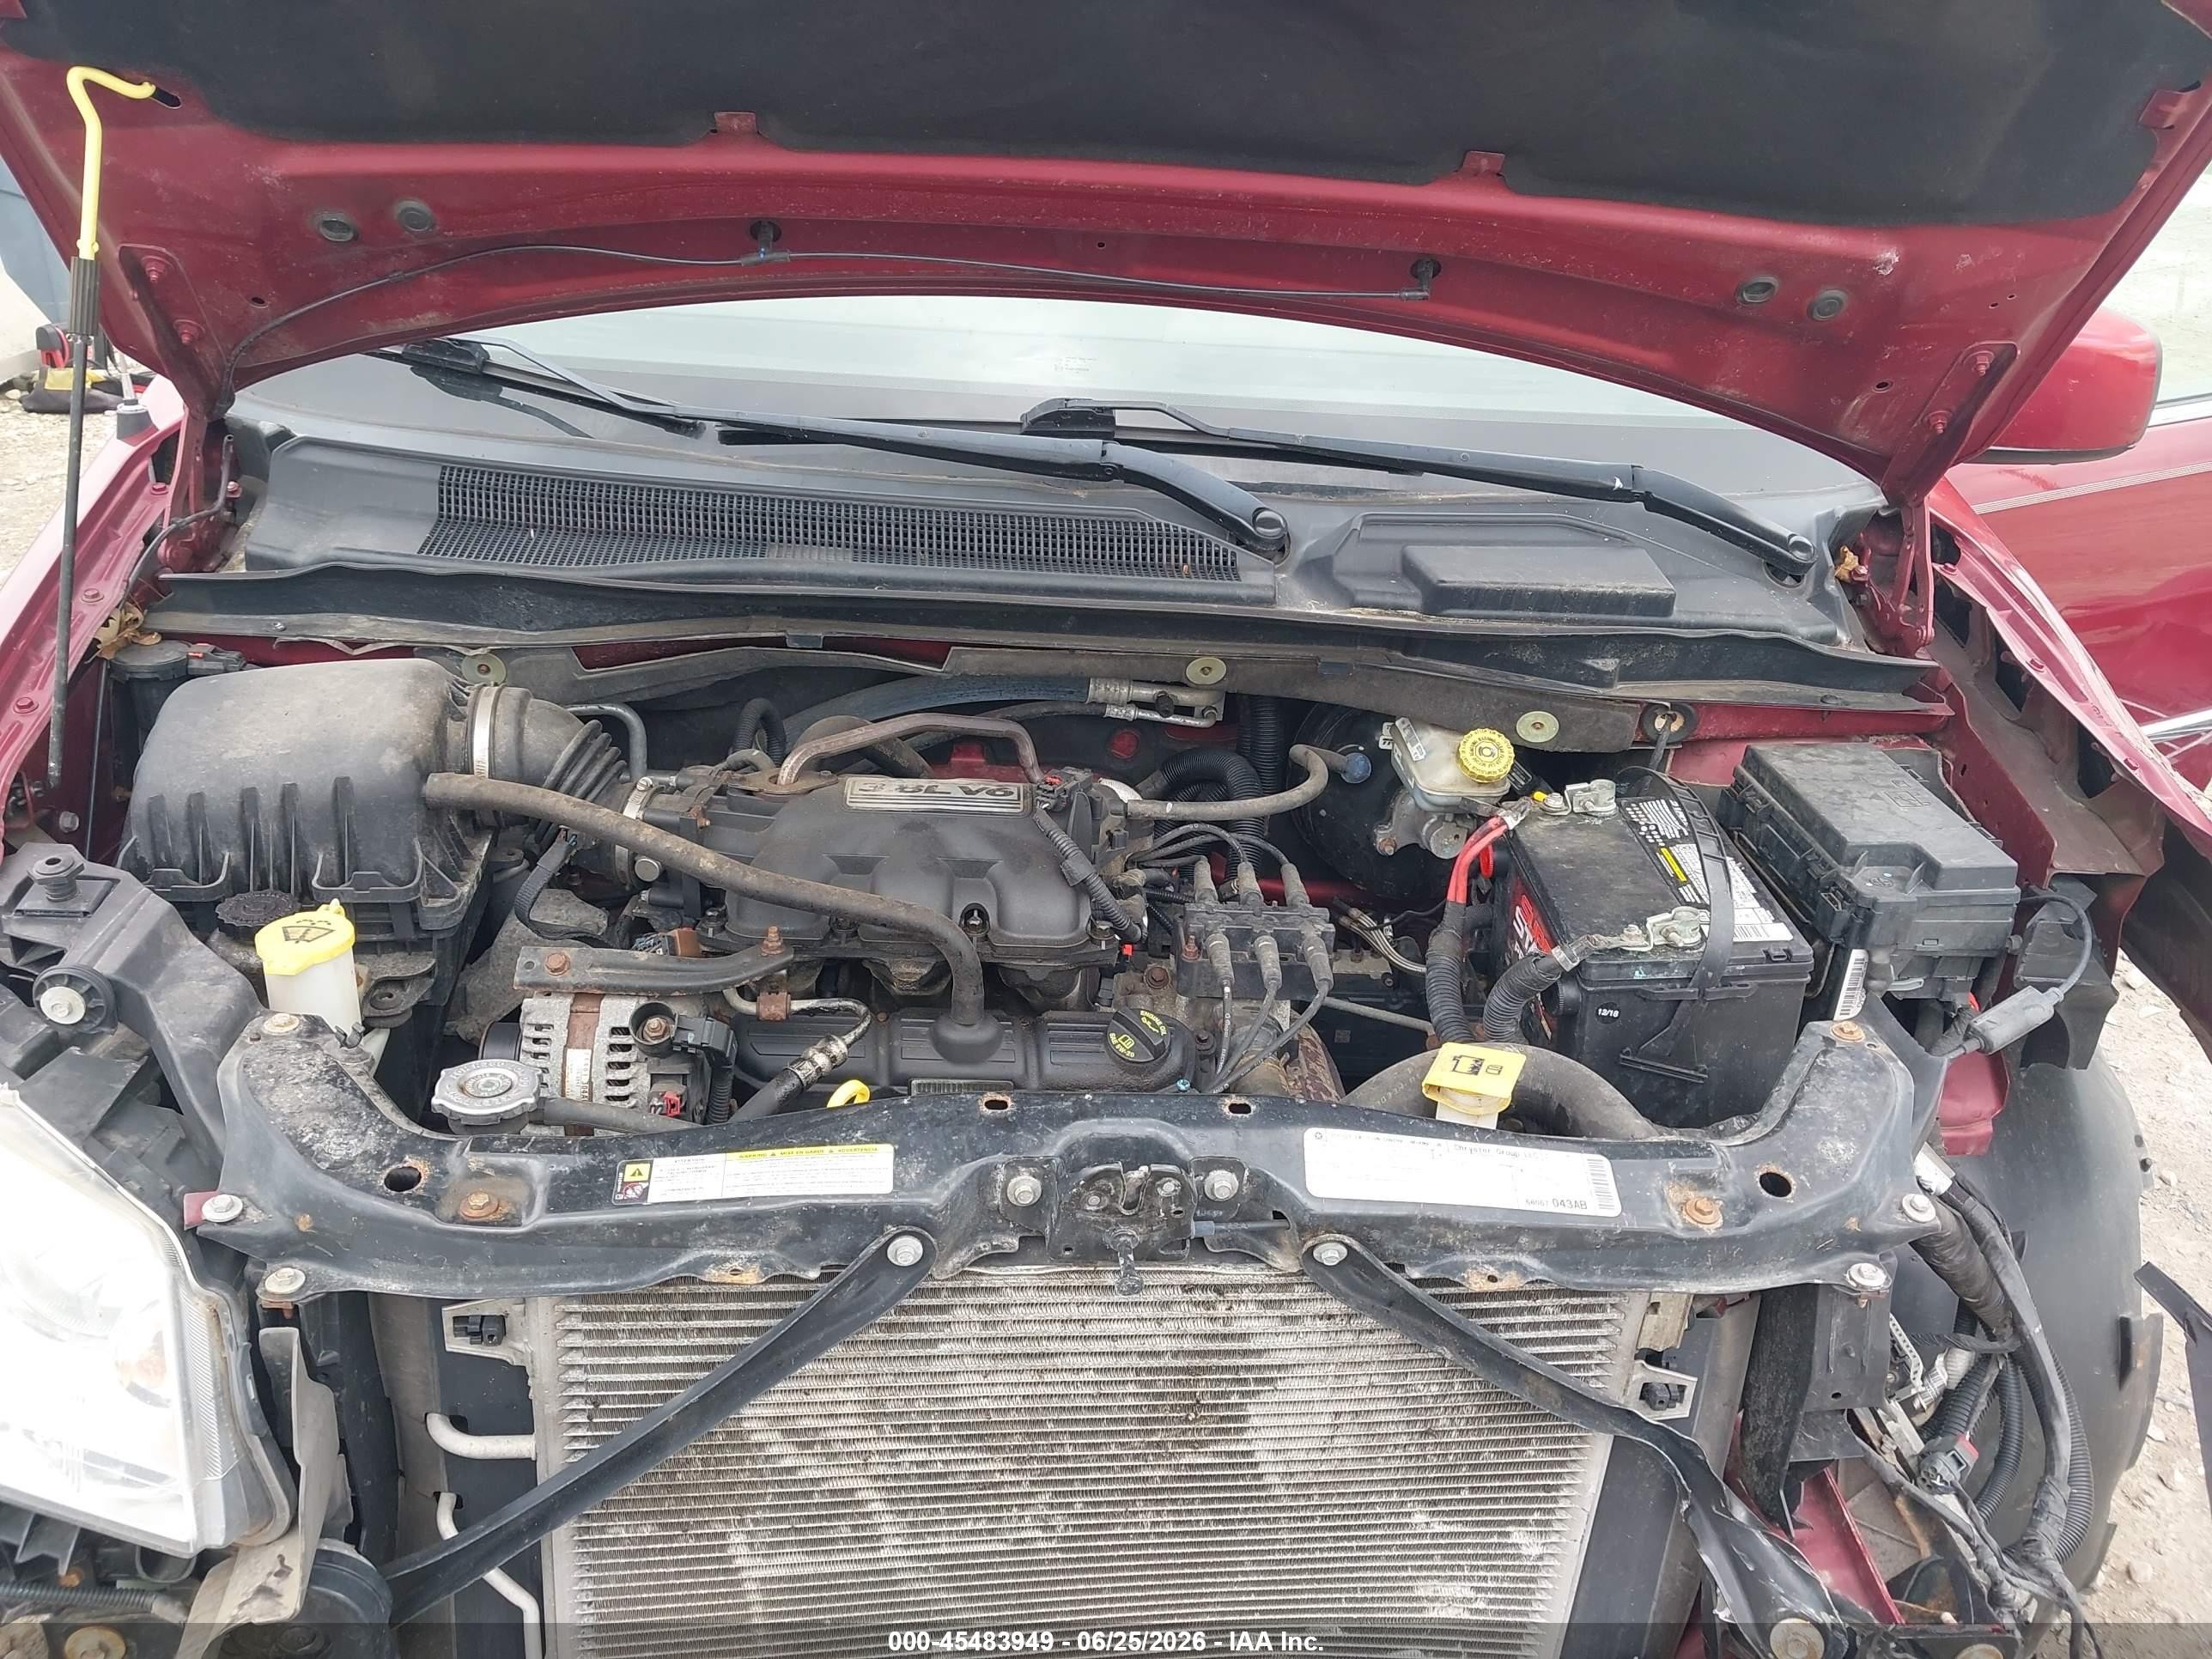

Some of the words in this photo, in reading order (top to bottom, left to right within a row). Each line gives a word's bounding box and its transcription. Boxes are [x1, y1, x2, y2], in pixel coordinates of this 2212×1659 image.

[859, 782, 951, 795] 38L
[957, 785, 1014, 797] V6
[1139, 1010, 1164, 1027] ENGINE
[1597, 1007, 1620, 1018] 12/18
[1552, 1198, 1588, 1210] 043AB
